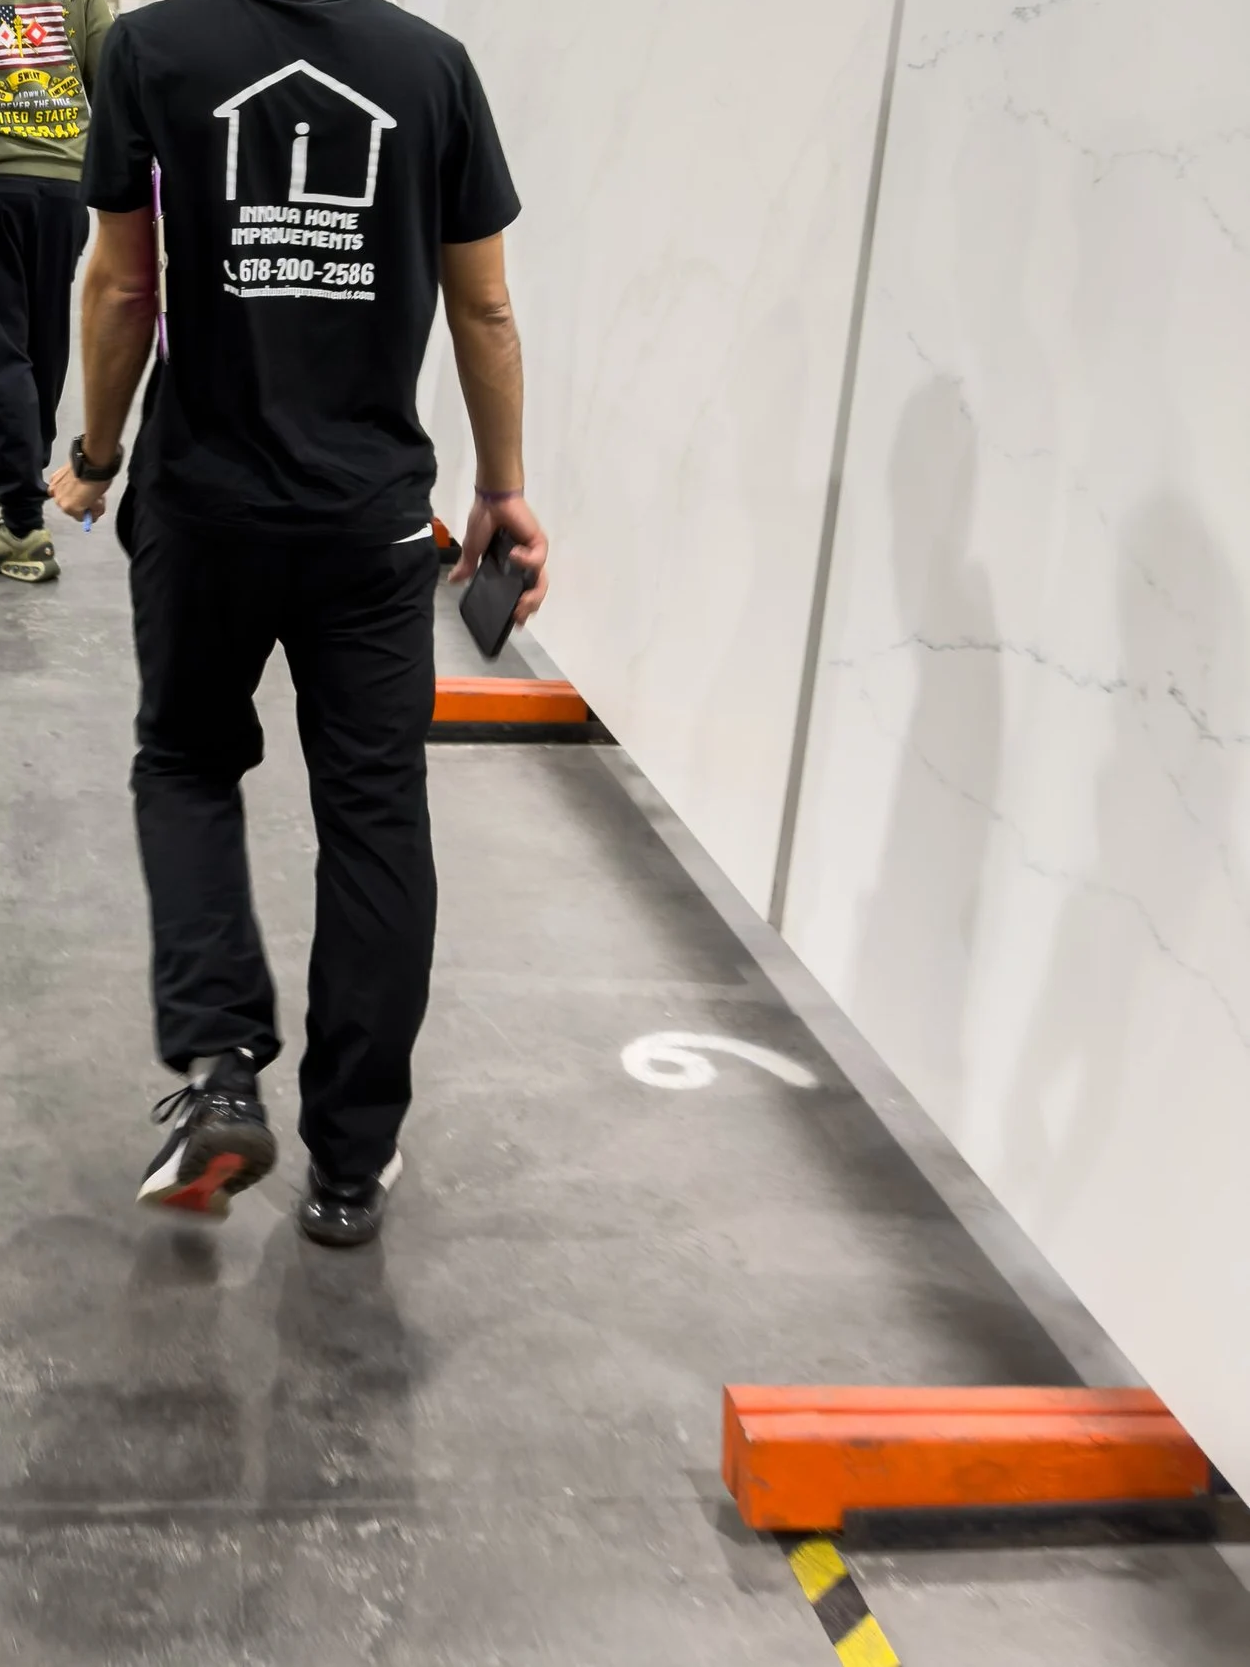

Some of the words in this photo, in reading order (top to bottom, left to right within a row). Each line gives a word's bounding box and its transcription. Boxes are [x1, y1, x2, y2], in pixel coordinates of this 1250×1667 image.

[23, 90, 40, 99] OWN
[33, 99, 50, 108] THE
[52, 97, 71, 106] TITLE
[35, 107, 78, 123] STATES
[304, 209, 360, 231] HOME
[239, 257, 375, 285] 678-200-2586
